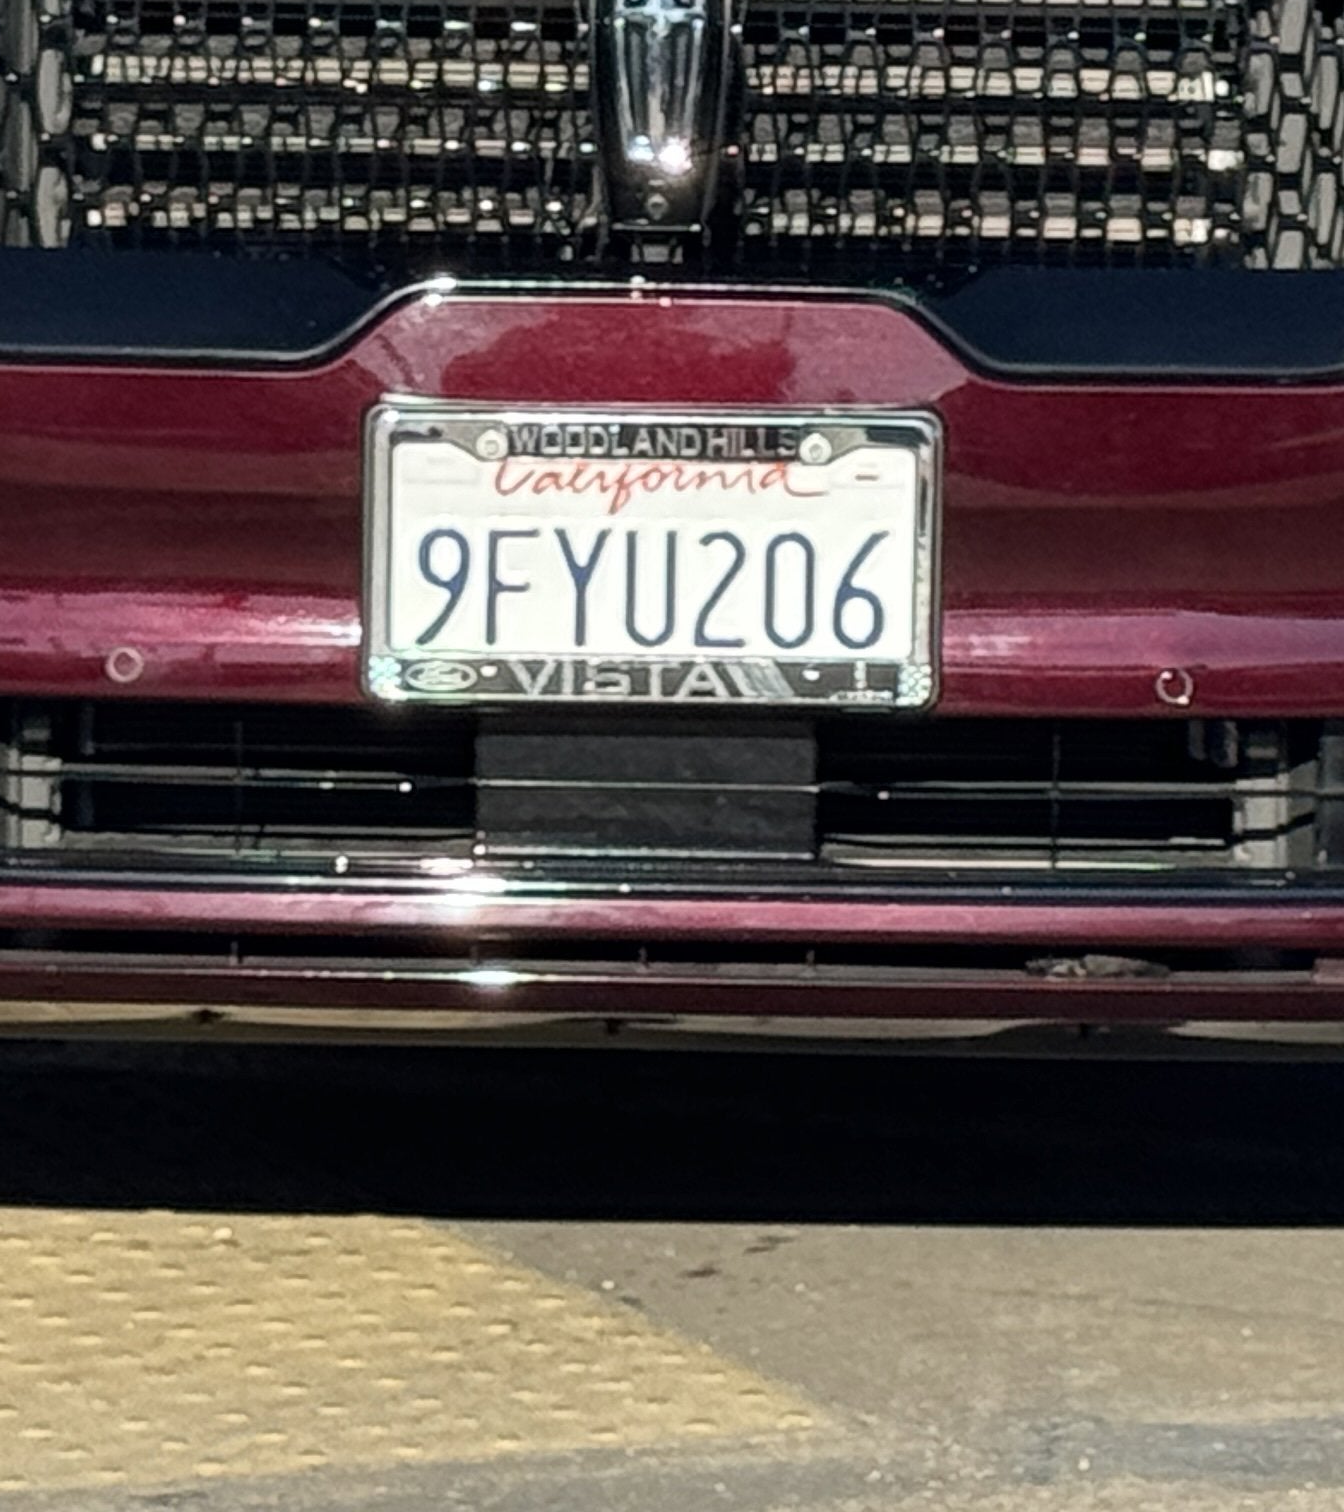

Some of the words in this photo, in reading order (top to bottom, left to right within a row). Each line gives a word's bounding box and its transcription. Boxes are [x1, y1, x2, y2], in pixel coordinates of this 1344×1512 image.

[508, 424, 704, 457] WOODLAND
[708, 425, 797, 458] HILLS
[494, 458, 830, 515] California
[415, 528, 890, 650] 9FYU206
[508, 659, 731, 698] VISTA
